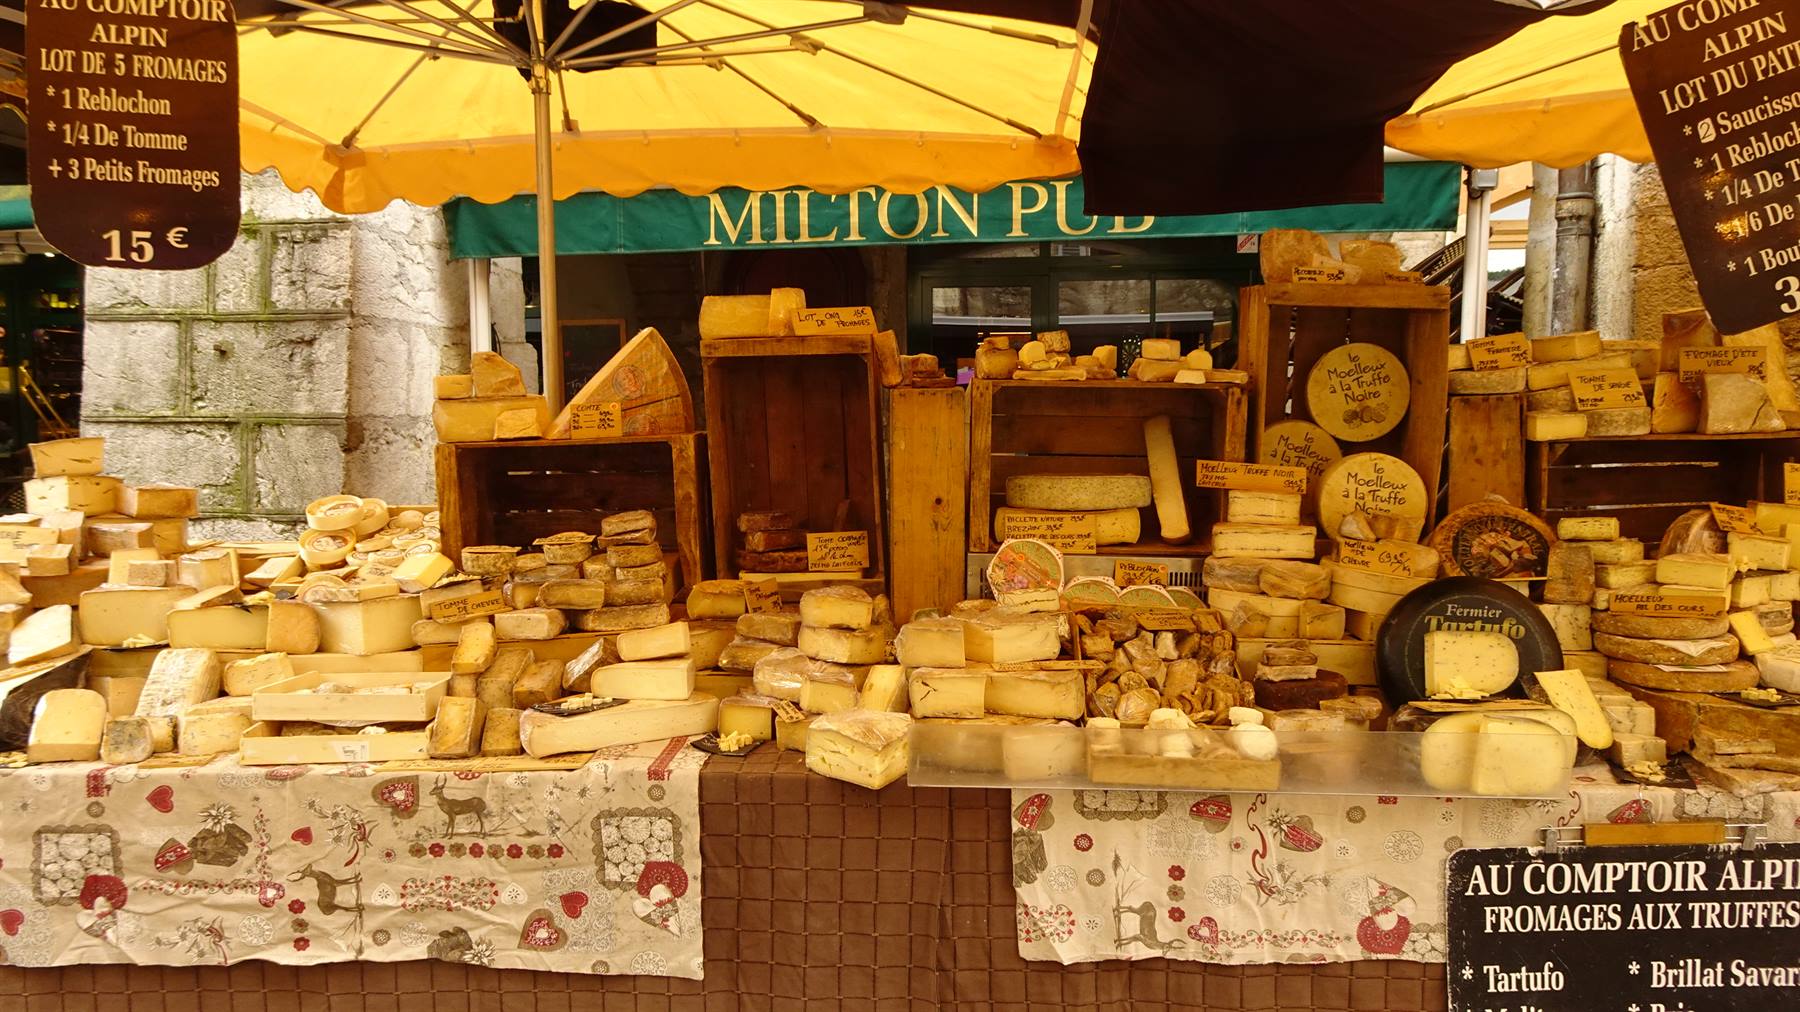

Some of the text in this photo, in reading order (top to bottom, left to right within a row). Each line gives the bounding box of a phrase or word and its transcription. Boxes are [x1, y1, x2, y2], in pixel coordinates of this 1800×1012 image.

[87, 0, 229, 23] COMPTOIR
[89, 22, 168, 48] ALPIN
[1632, 0, 1760, 52] AU COM
[1703, 11, 1788, 63] ALPIN
[40, 48, 227, 84] LOT DE 5 FROMAGES
[1659, 76, 1708, 115] LOT
[1710, 61, 1749, 96] DU
[62, 87, 172, 116] 1 Reblochon
[62, 121, 188, 151] 1/4 De Tomme
[1699, 121, 1714, 141] 2
[68, 158, 80, 180] 3
[84, 157, 133, 183] Petits
[137, 160, 220, 192] Fromages
[1711, 152, 1725, 174] 1
[1721, 178, 1753, 206] 1/4
[1754, 170, 1784, 194] De
[703, 184, 978, 245] MILTON
[1763, 202, 1795, 227] De
[102, 227, 189, 264] 15 €
[1744, 256, 1758, 277] 1
[797, 311, 817, 322] LOT
[1348, 353, 1360, 363] le
[1683, 350, 1729, 359] FROMAGE
[1327, 362, 1386, 381] Moelleux
[1339, 380, 1352, 391] la
[1351, 371, 1391, 389] Truffe
[1344, 389, 1381, 405] Noire
[1278, 434, 1332, 463] Moelleux
[1304, 432, 1314, 444] le
[1281, 450, 1291, 464] la
[1373, 462, 1384, 474] le
[1347, 472, 1407, 491] Moelleux
[1355, 487, 1365, 500] la
[1368, 489, 1406, 505] Truffe
[457, 606, 468, 614] DE
[1446, 603, 1502, 618] Fermier
[1424, 615, 1526, 639] Tartufo
[1465, 859, 1800, 896] AU COMPTOIR ALPI
[1484, 900, 1800, 933] FROMAGES AUX TRUFFES
[1483, 961, 1565, 993] Tartufo
[1651, 959, 1800, 988] Brillat Savar
